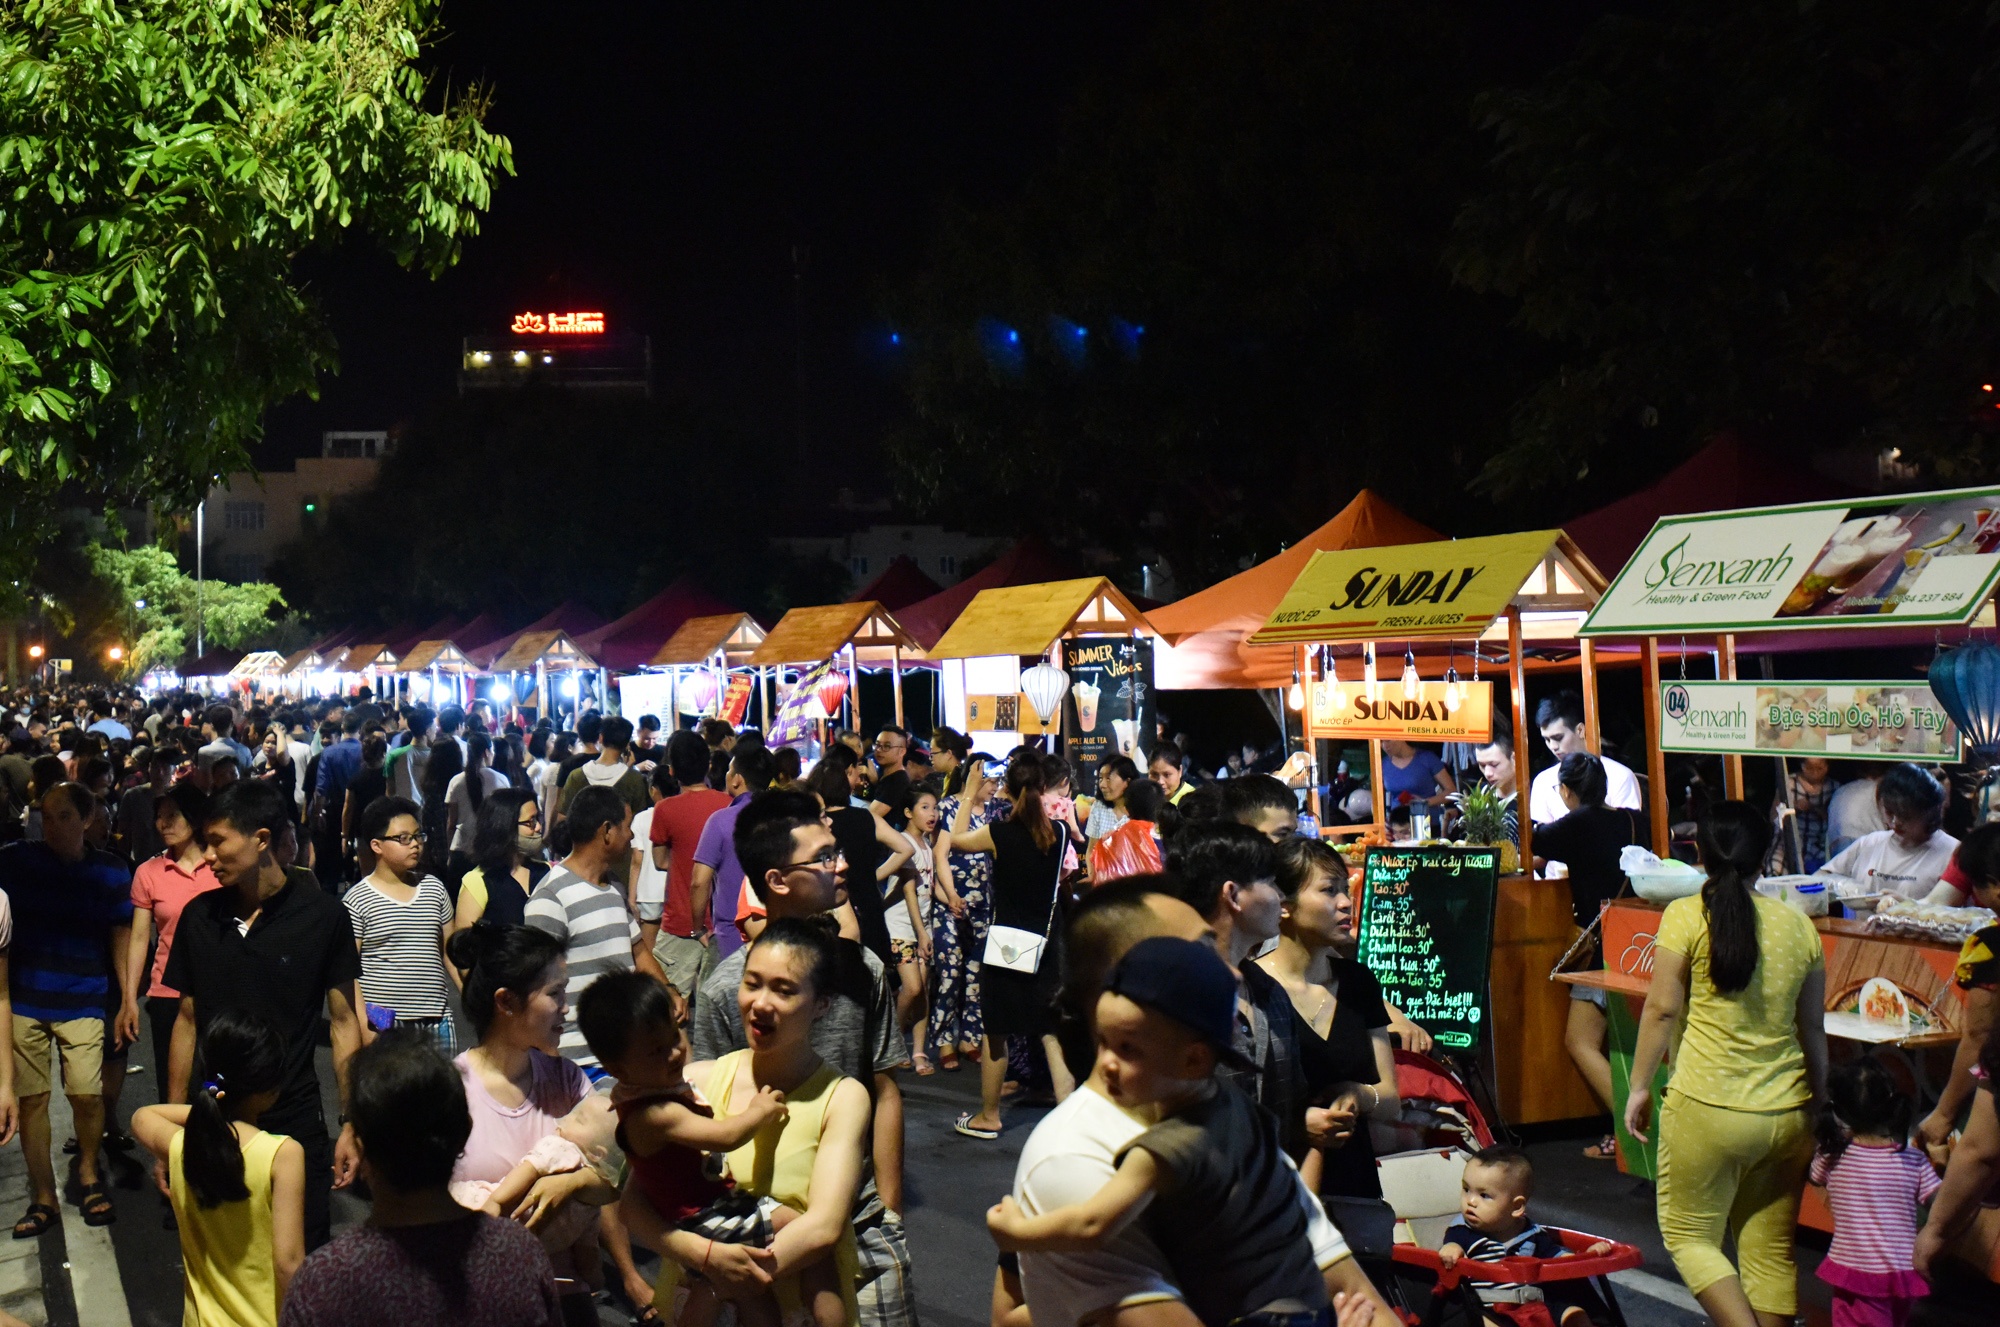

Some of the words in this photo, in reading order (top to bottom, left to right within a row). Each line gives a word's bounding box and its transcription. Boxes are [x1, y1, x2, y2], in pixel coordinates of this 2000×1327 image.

[1633, 533, 1794, 605] Senxanh
[1330, 565, 1486, 611] SUNDAY
[1646, 594, 1688, 606] Healthy
[1690, 592, 1698, 603] &
[1702, 591, 1736, 602] Green
[1738, 589, 1771, 601] Food
[1919, 593, 1940, 603] 237
[1941, 592, 1964, 602] 884
[1380, 617, 1415, 627] FRESH
[1415, 616, 1422, 625] &
[1423, 614, 1464, 625] JUICES
[1068, 644, 1114, 666] SUMMER
[1104, 659, 1143, 678] Vibes
[1668, 691, 1686, 712] 04
[1769, 704, 1804, 731] Đặc
[1807, 704, 1841, 727] sản
[1845, 702, 1873, 728] Ốc
[1877, 702, 1905, 728] Hồ
[1910, 707, 1947, 734] Tây
[1439, 727, 1466, 735] JUICES
[1686, 731, 1706, 740] Healthy
[1731, 732, 1746, 740] Food
[1441, 855, 1461, 877] cây
[1368, 938, 1397, 953] Chanh
[1368, 954, 1397, 970] Chanh
